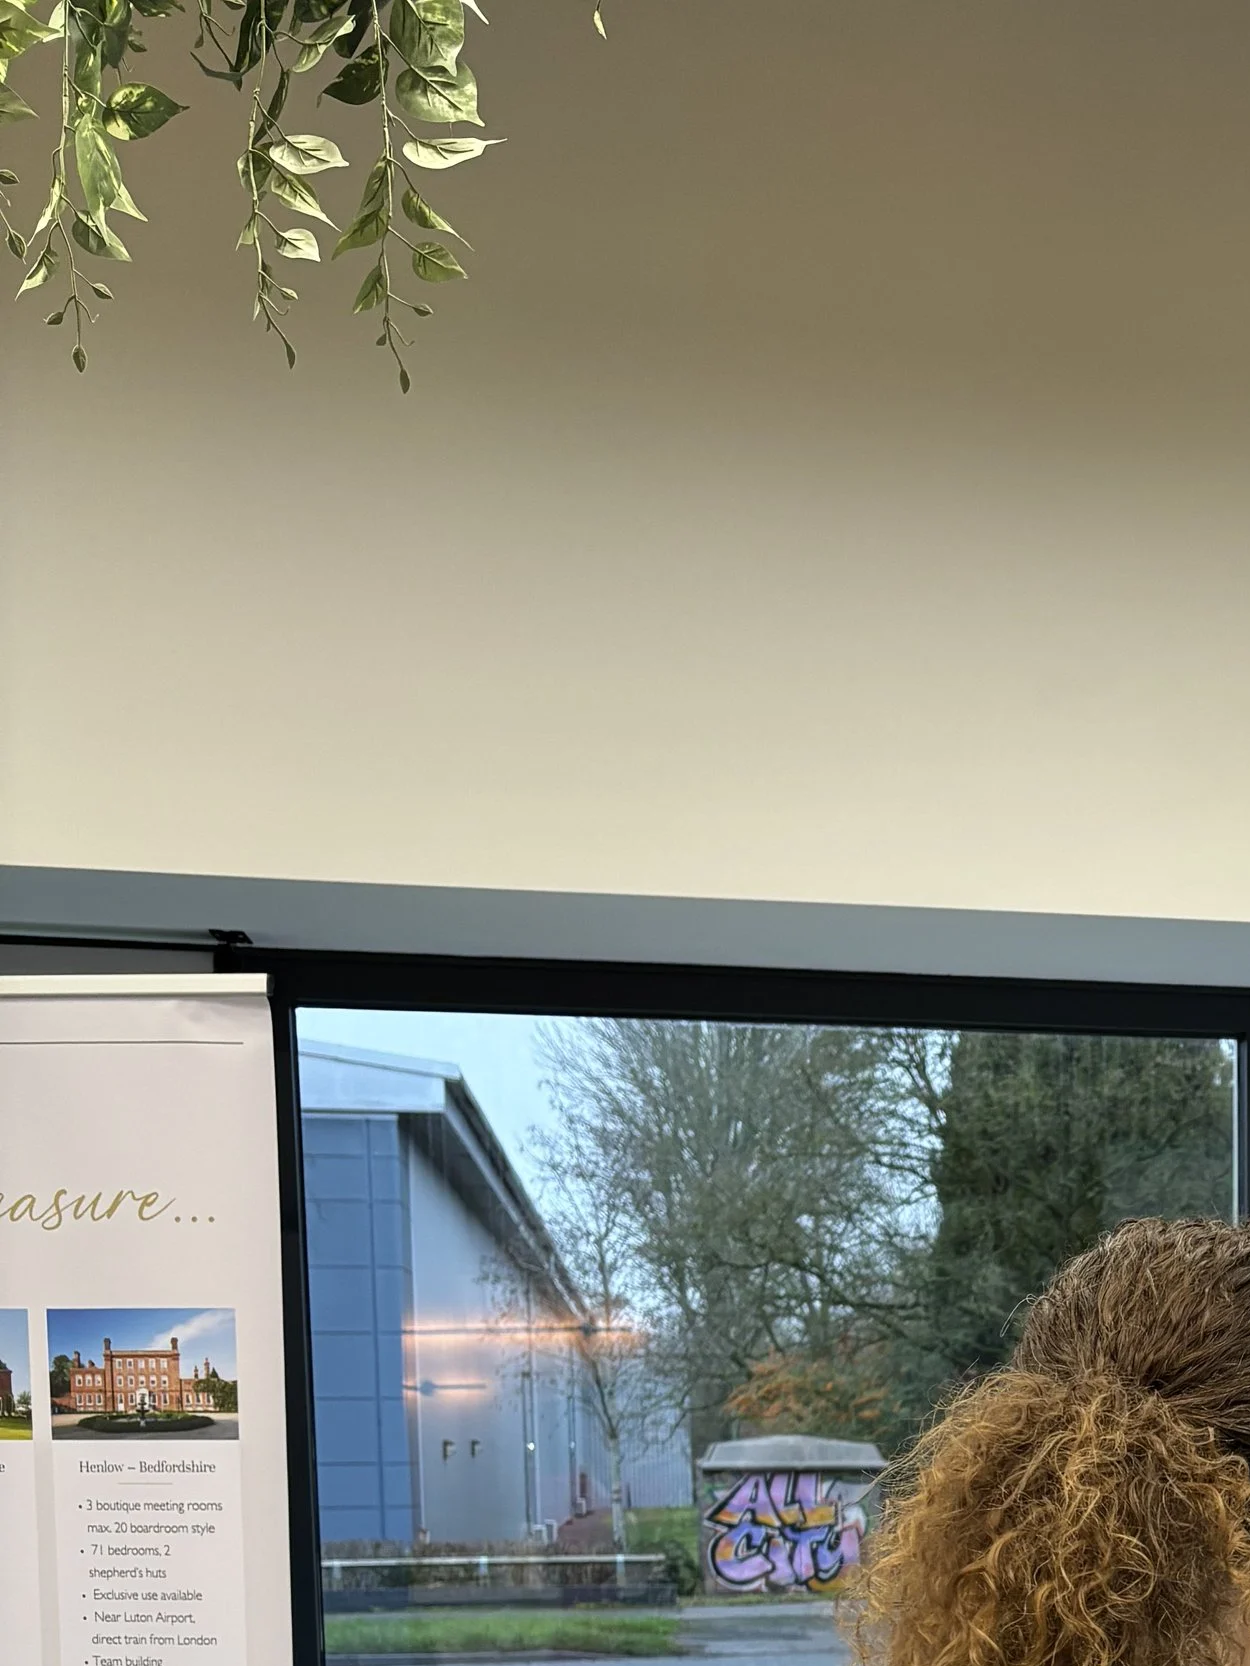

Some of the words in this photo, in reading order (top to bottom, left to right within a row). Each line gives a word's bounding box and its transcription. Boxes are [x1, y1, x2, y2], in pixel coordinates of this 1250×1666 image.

[79, 1460, 124, 1473] Henlow
[139, 1460, 216, 1473] Bedfordshire
[86, 1499, 93, 1511] 3
[96, 1500, 141, 1514] boutique
[144, 1500, 185, 1514] meeting
[187, 1502, 223, 1511] rooms
[114, 1522, 127, 1533] 20
[130, 1522, 188, 1533] boardroom
[191, 1522, 215, 1535] style
[91, 1544, 103, 1556] 71
[107, 1545, 162, 1557] bedrooms,
[164, 1545, 171, 1556] 2
[146, 1567, 167, 1578] huts
[93, 1589, 138, 1601] Exclusive
[141, 1592, 158, 1601] use
[160, 1589, 203, 1601] available
[94, 1612, 121, 1623] Near
[124, 1612, 153, 1623] Luton
[92, 1634, 122, 1645] direct
[124, 1634, 147, 1645] train
[150, 1634, 174, 1645] from
[177, 1634, 217, 1646] London
[92, 1656, 122, 1666] Team
